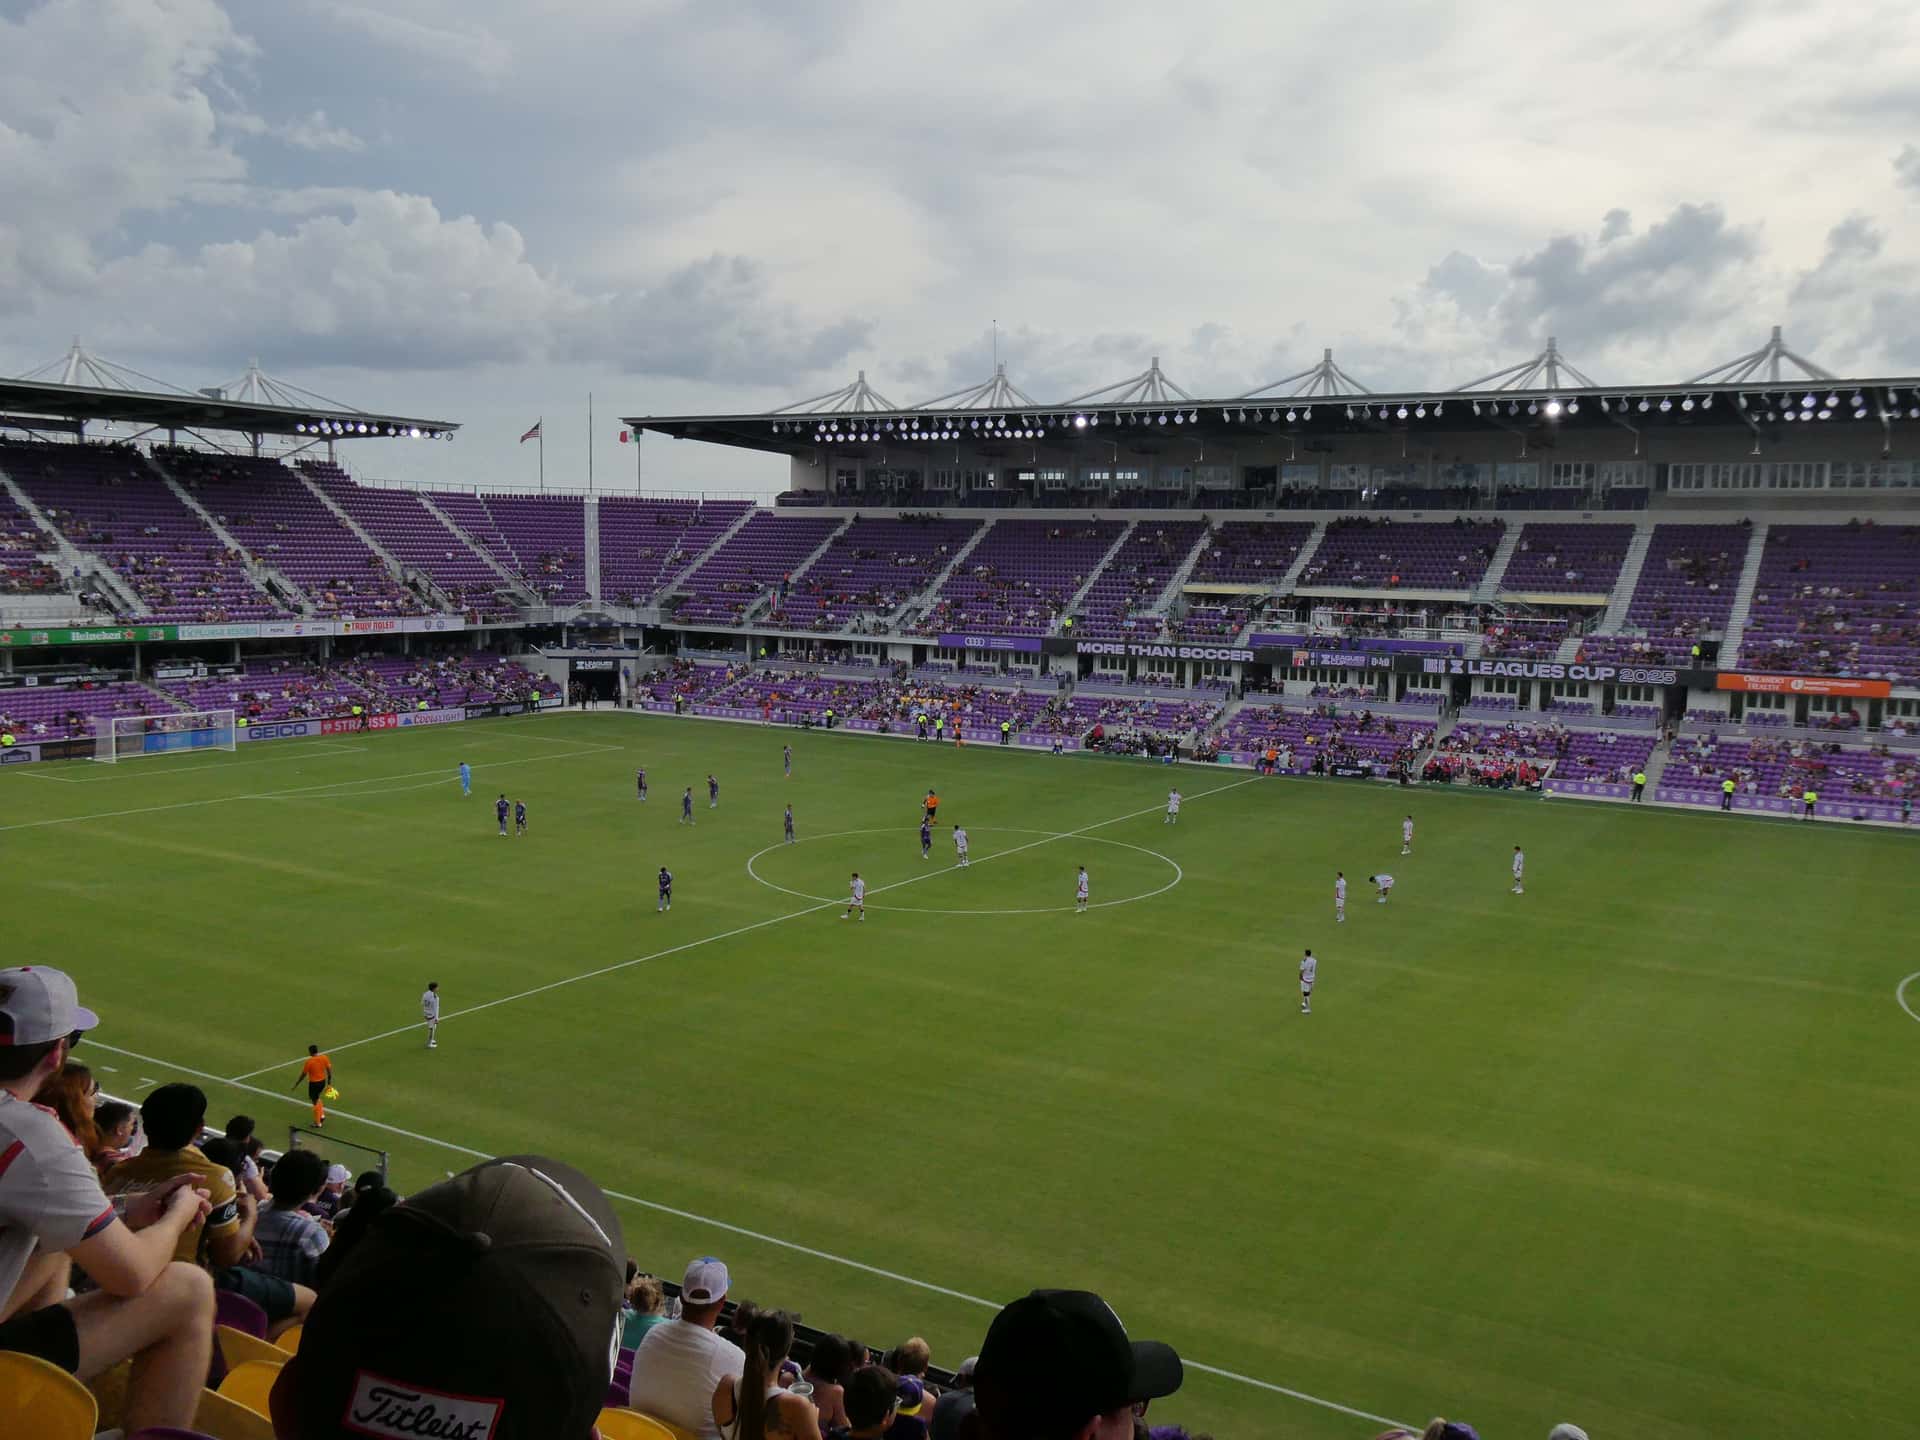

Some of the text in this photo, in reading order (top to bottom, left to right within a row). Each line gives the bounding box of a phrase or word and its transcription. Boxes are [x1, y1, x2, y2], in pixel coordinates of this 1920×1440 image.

[71, 630, 122, 642] Heineken
[1076, 642, 1254, 662] MORE THAN SOCCER
[1467, 660, 1677, 685] LEAGUES CUP 2025
[249, 723, 308, 740] GEICO
[353, 1386, 487, 1440] Titleist
